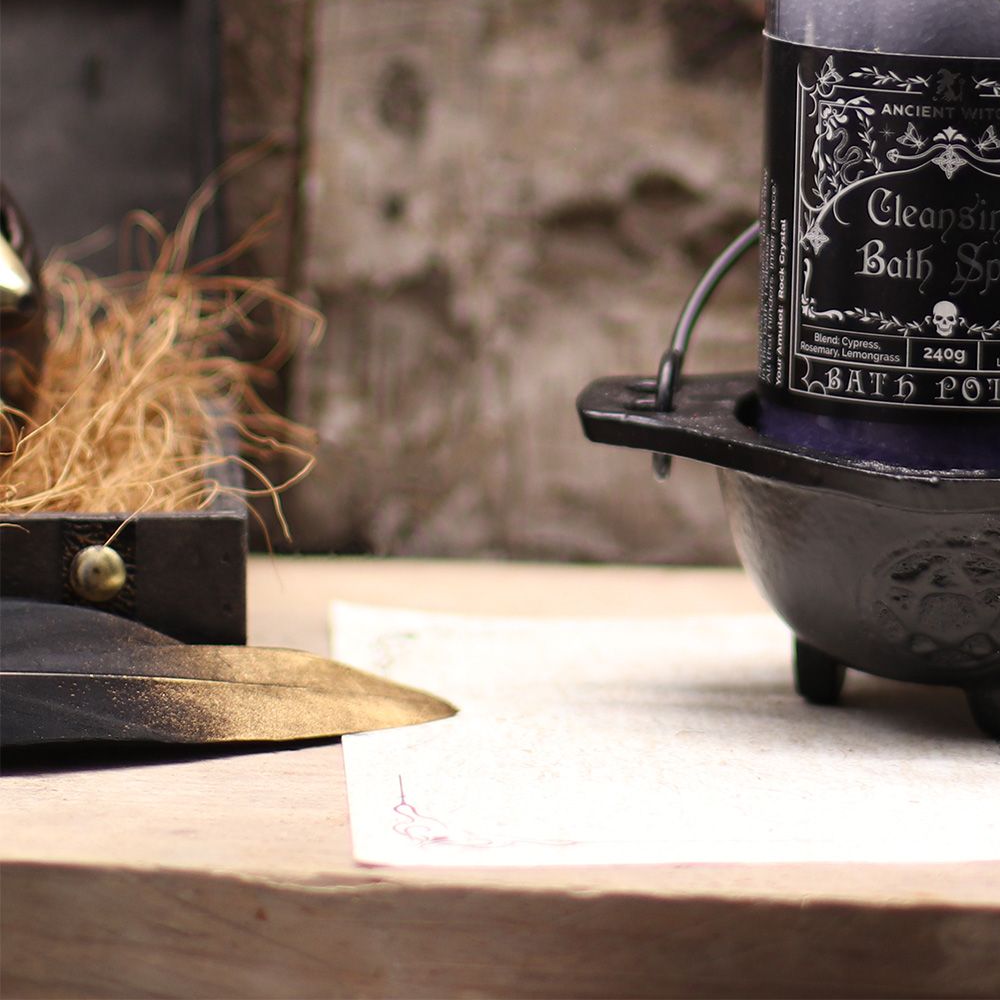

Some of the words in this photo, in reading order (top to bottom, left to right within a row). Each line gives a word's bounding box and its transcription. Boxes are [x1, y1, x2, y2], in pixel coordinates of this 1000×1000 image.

[881, 103, 955, 119] ANCIENT
[779, 219, 788, 264] Crystal
[854, 239, 933, 295] Bath
[778, 267, 786, 299] Rock
[800, 341, 841, 357] Rosemary,
[841, 350, 900, 363] Lemongrass
[814, 332, 841, 345] Blend:
[841, 336, 881, 351] Cypress,
[923, 347, 966, 364] 240g
[775, 358, 784, 386] Your
[824, 366, 917, 402] BATH
